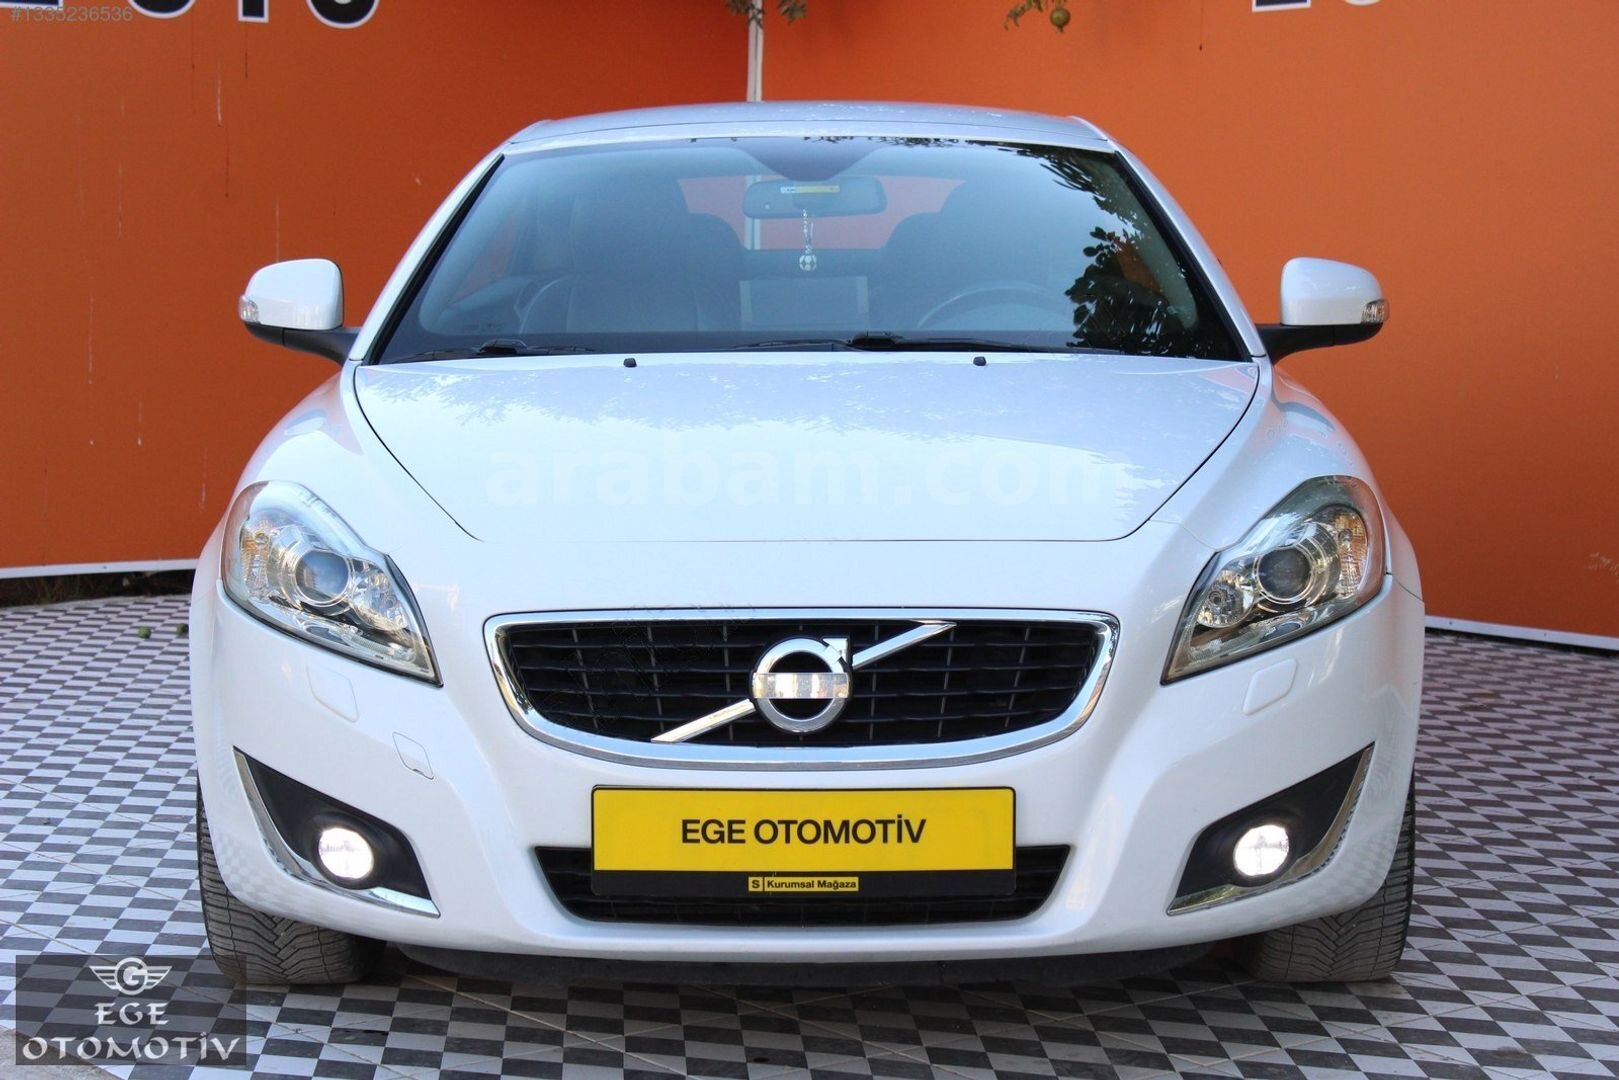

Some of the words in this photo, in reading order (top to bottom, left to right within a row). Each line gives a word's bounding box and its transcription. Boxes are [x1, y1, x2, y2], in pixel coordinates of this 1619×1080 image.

[682, 819, 746, 844] EGE
[753, 814, 927, 844] OTOMOTİV
[751, 879, 760, 889] S
[767, 880, 815, 889] Kurumsal
[817, 880, 857, 890] Mağaza
